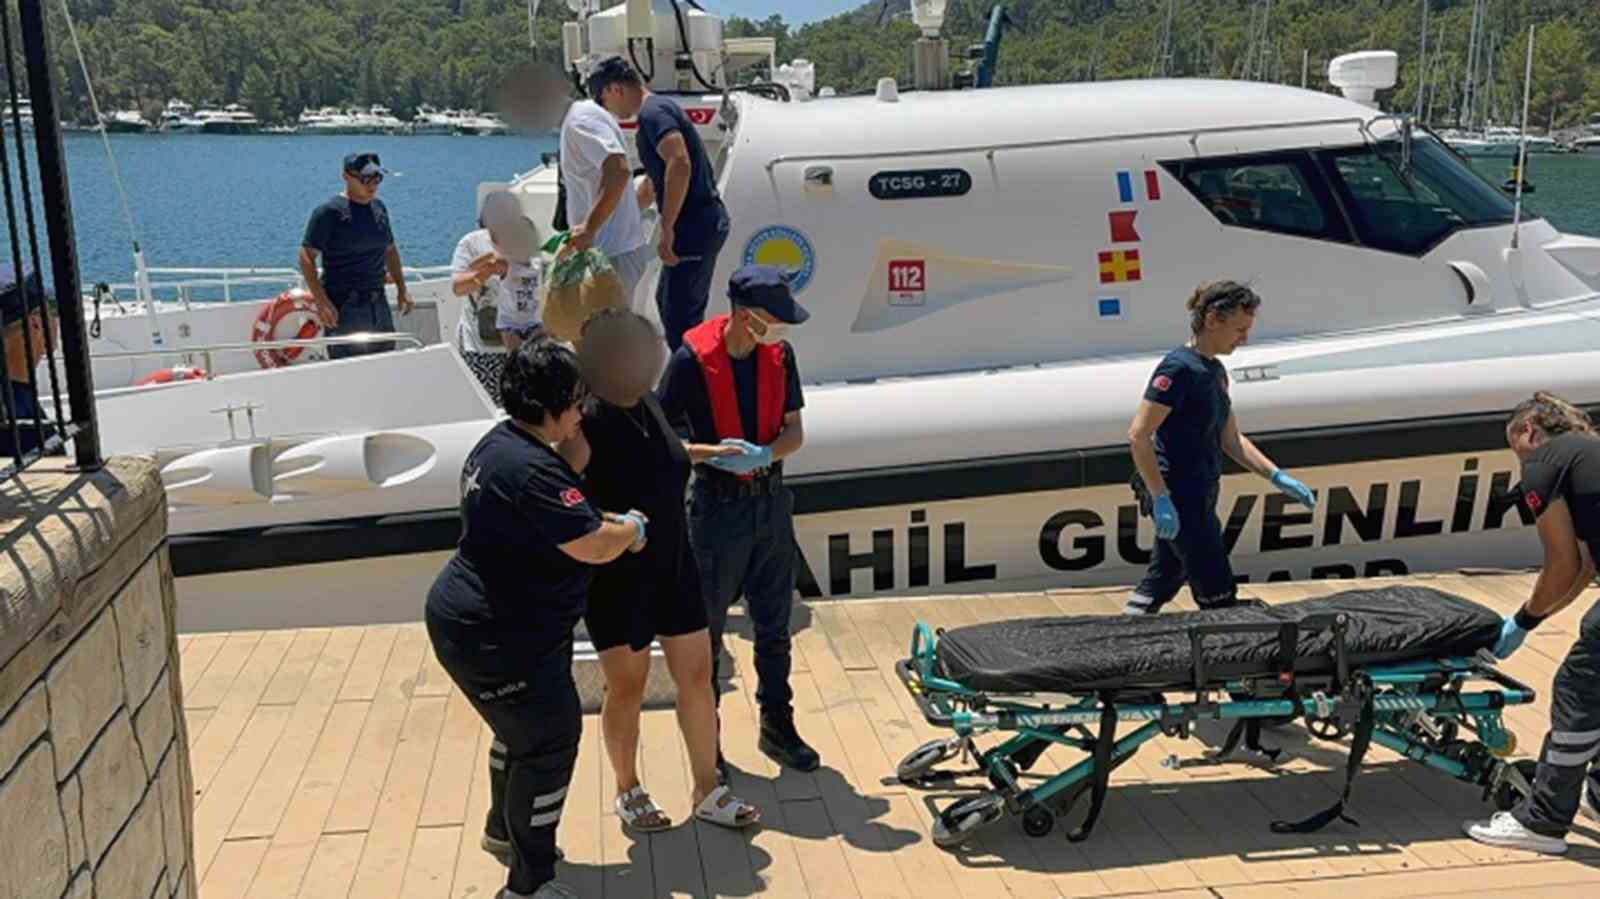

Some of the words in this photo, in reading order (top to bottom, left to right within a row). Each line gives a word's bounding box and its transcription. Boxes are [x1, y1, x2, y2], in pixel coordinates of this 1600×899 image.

[877, 176, 926, 192] TCSG
[941, 173, 961, 188] 27
[892, 266, 921, 289] 112
